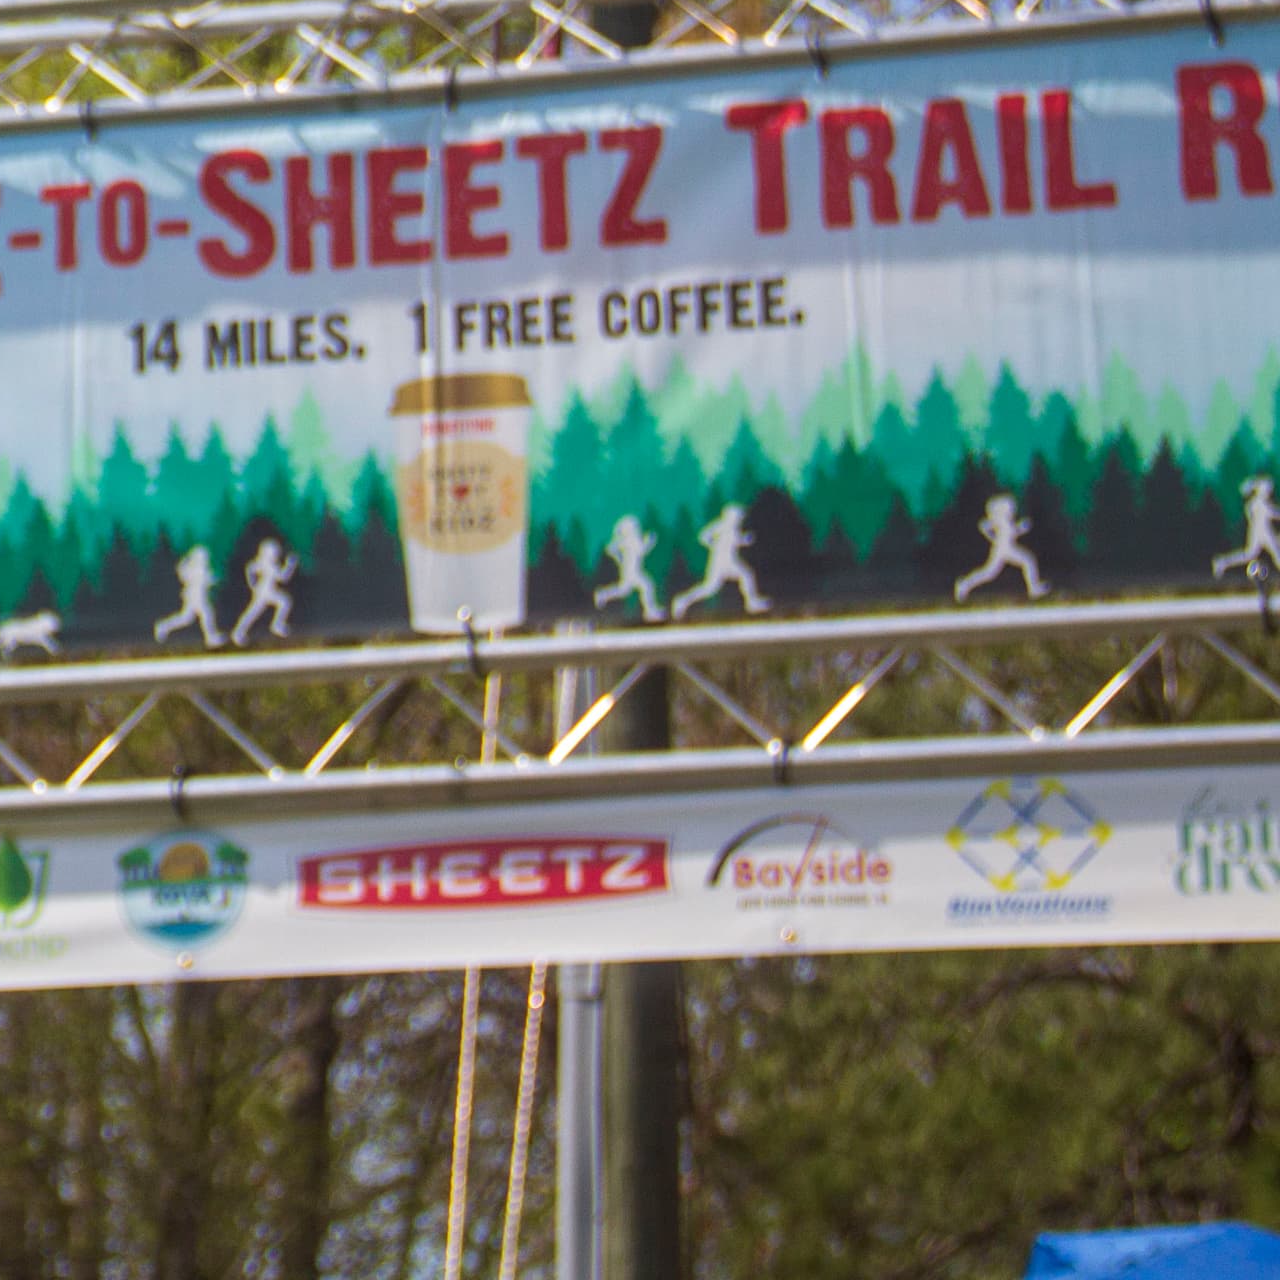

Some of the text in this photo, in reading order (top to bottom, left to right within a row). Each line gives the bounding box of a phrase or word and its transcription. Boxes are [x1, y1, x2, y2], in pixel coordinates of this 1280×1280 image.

[724, 87, 1118, 236] TRAIL
[1176, 59, 1280, 203] R
[130, 277, 807, 375] 14 MILES. 1 FREE COFFEE.
[317, 844, 652, 903] SHEETZ
[733, 848, 894, 892] Bayside
